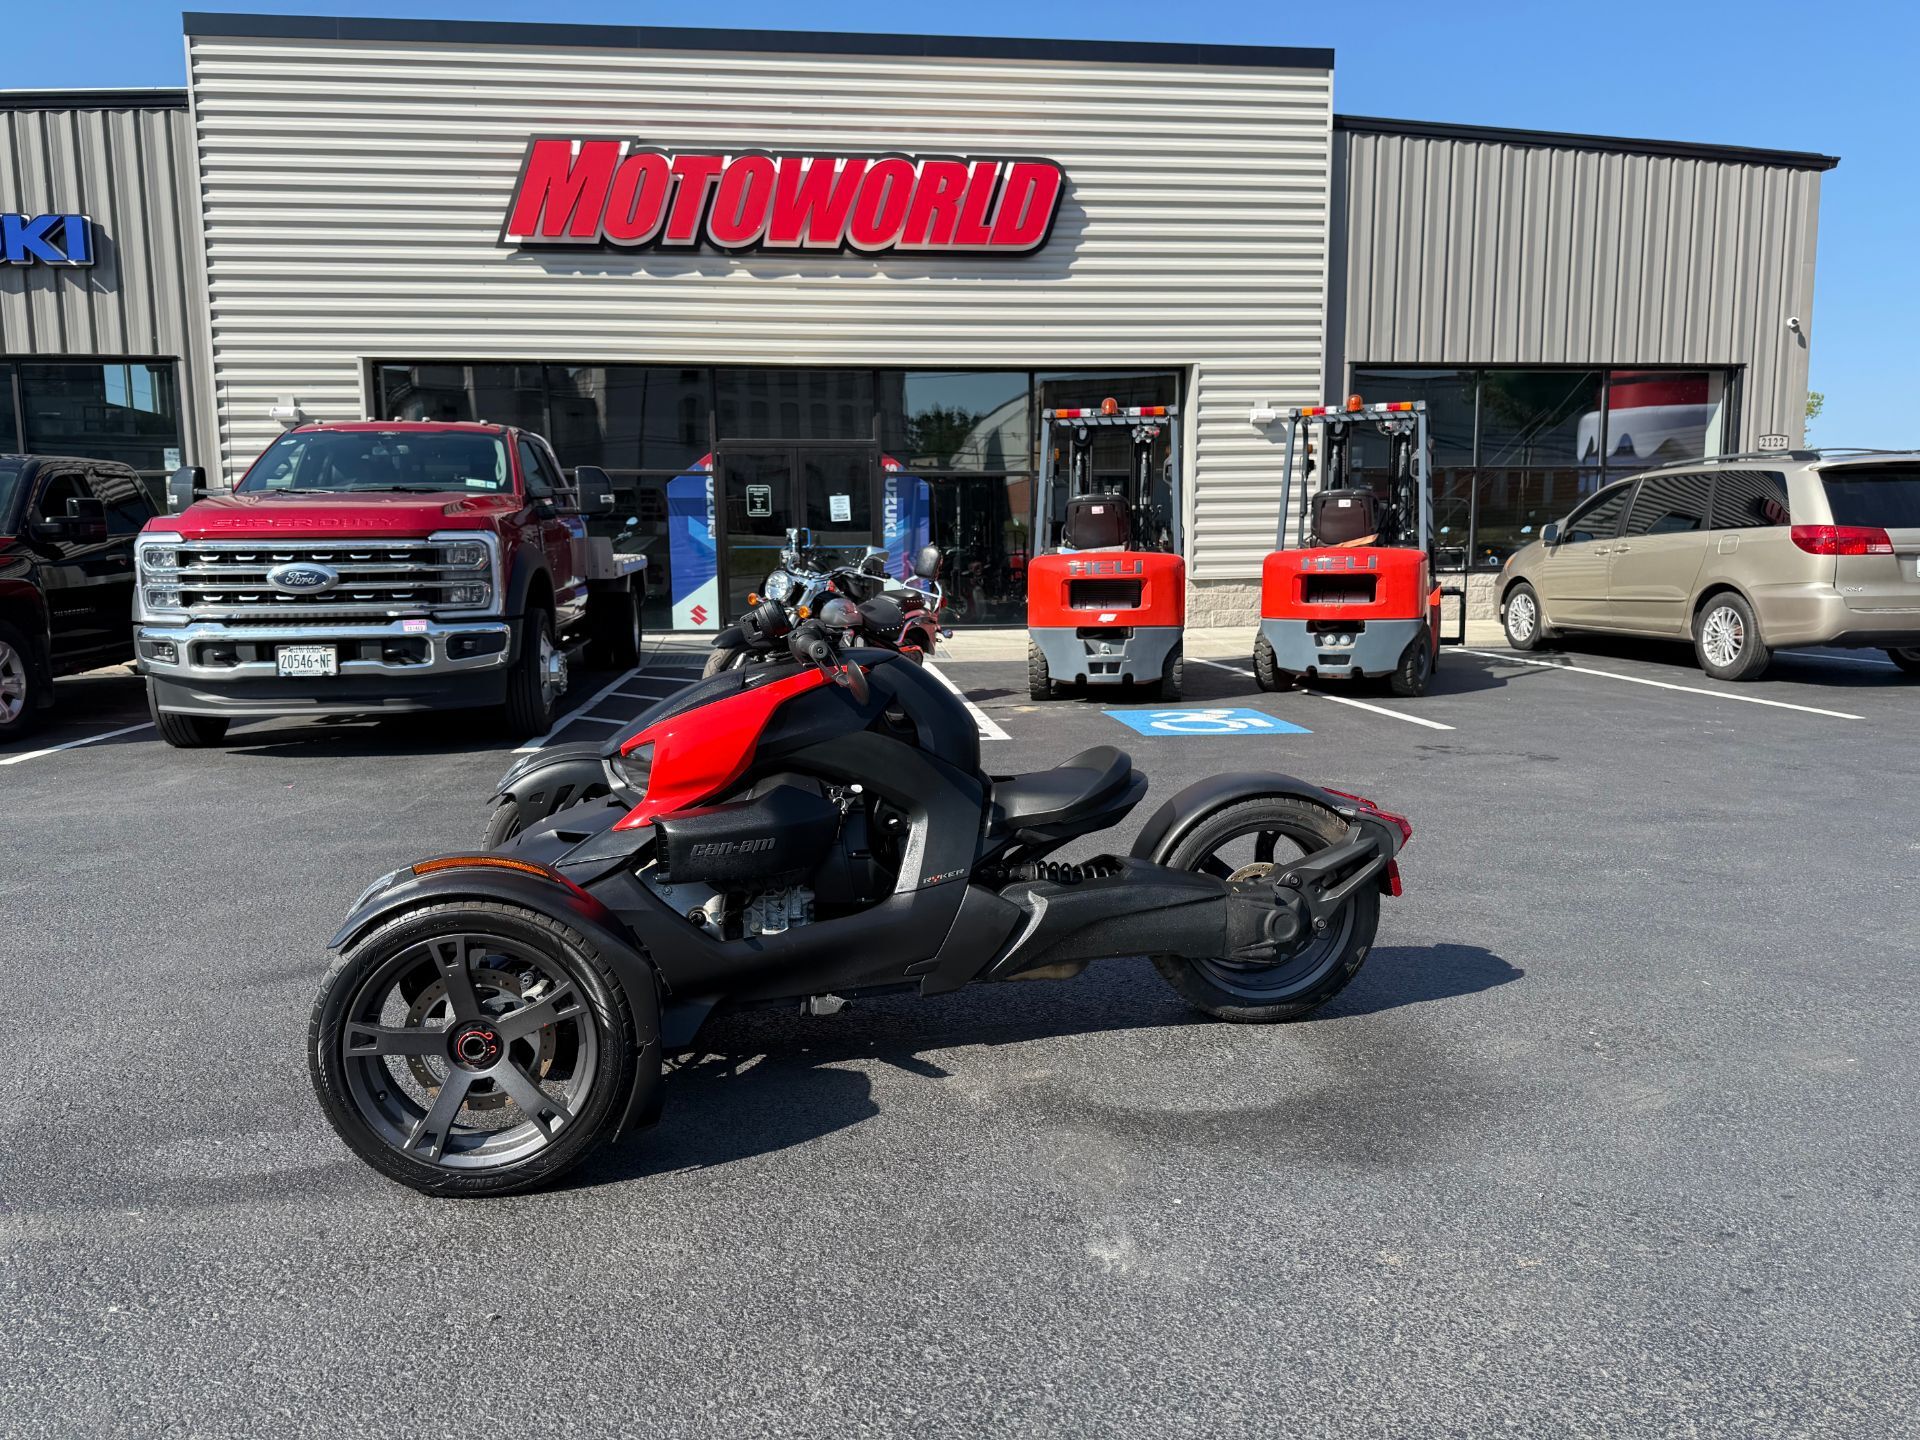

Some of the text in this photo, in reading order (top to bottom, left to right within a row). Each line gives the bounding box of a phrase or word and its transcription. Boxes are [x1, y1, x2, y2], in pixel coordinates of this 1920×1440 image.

[507, 138, 1062, 249] MOTOWORLD
[0, 214, 93, 265] KI
[1761, 437, 1784, 447] 2122
[885, 463, 898, 538] SUZUKI
[212, 517, 400, 528] SUPER DUTY
[1068, 560, 1144, 576] HELI
[1301, 555, 1378, 572] HELI
[285, 571, 318, 585] Ford
[690, 837, 776, 857] can-am
[923, 868, 965, 884] RYKER
